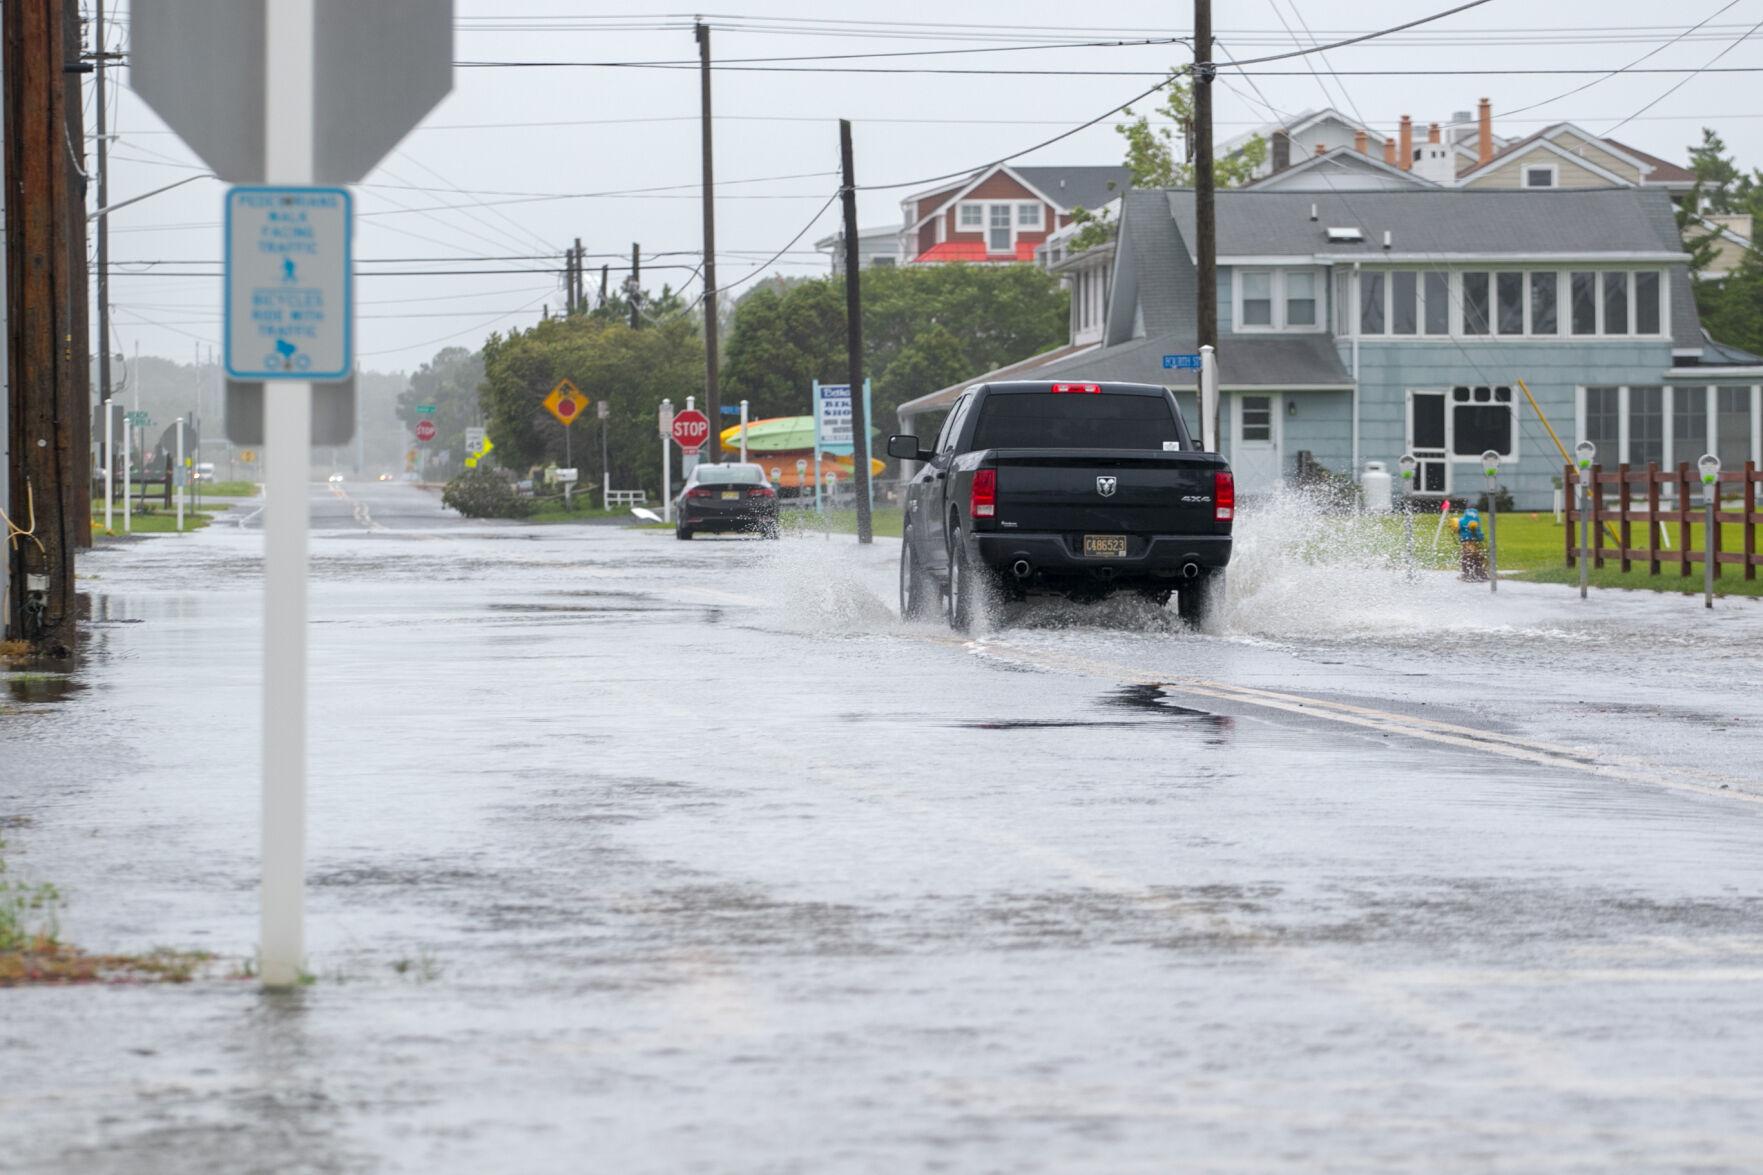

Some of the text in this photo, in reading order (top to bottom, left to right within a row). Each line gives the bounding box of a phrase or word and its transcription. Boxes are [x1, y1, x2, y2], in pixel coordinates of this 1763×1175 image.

[260, 226, 314, 238] FACING
[257, 241, 318, 254] TRAFFIC
[250, 293, 324, 306] BICYCLES
[250, 309, 325, 321] RIDE WITH
[257, 325, 318, 338] TRAFFIC
[416, 426, 436, 435] STOP
[674, 421, 707, 437] STOP
[1086, 539, 1124, 551] C486523
